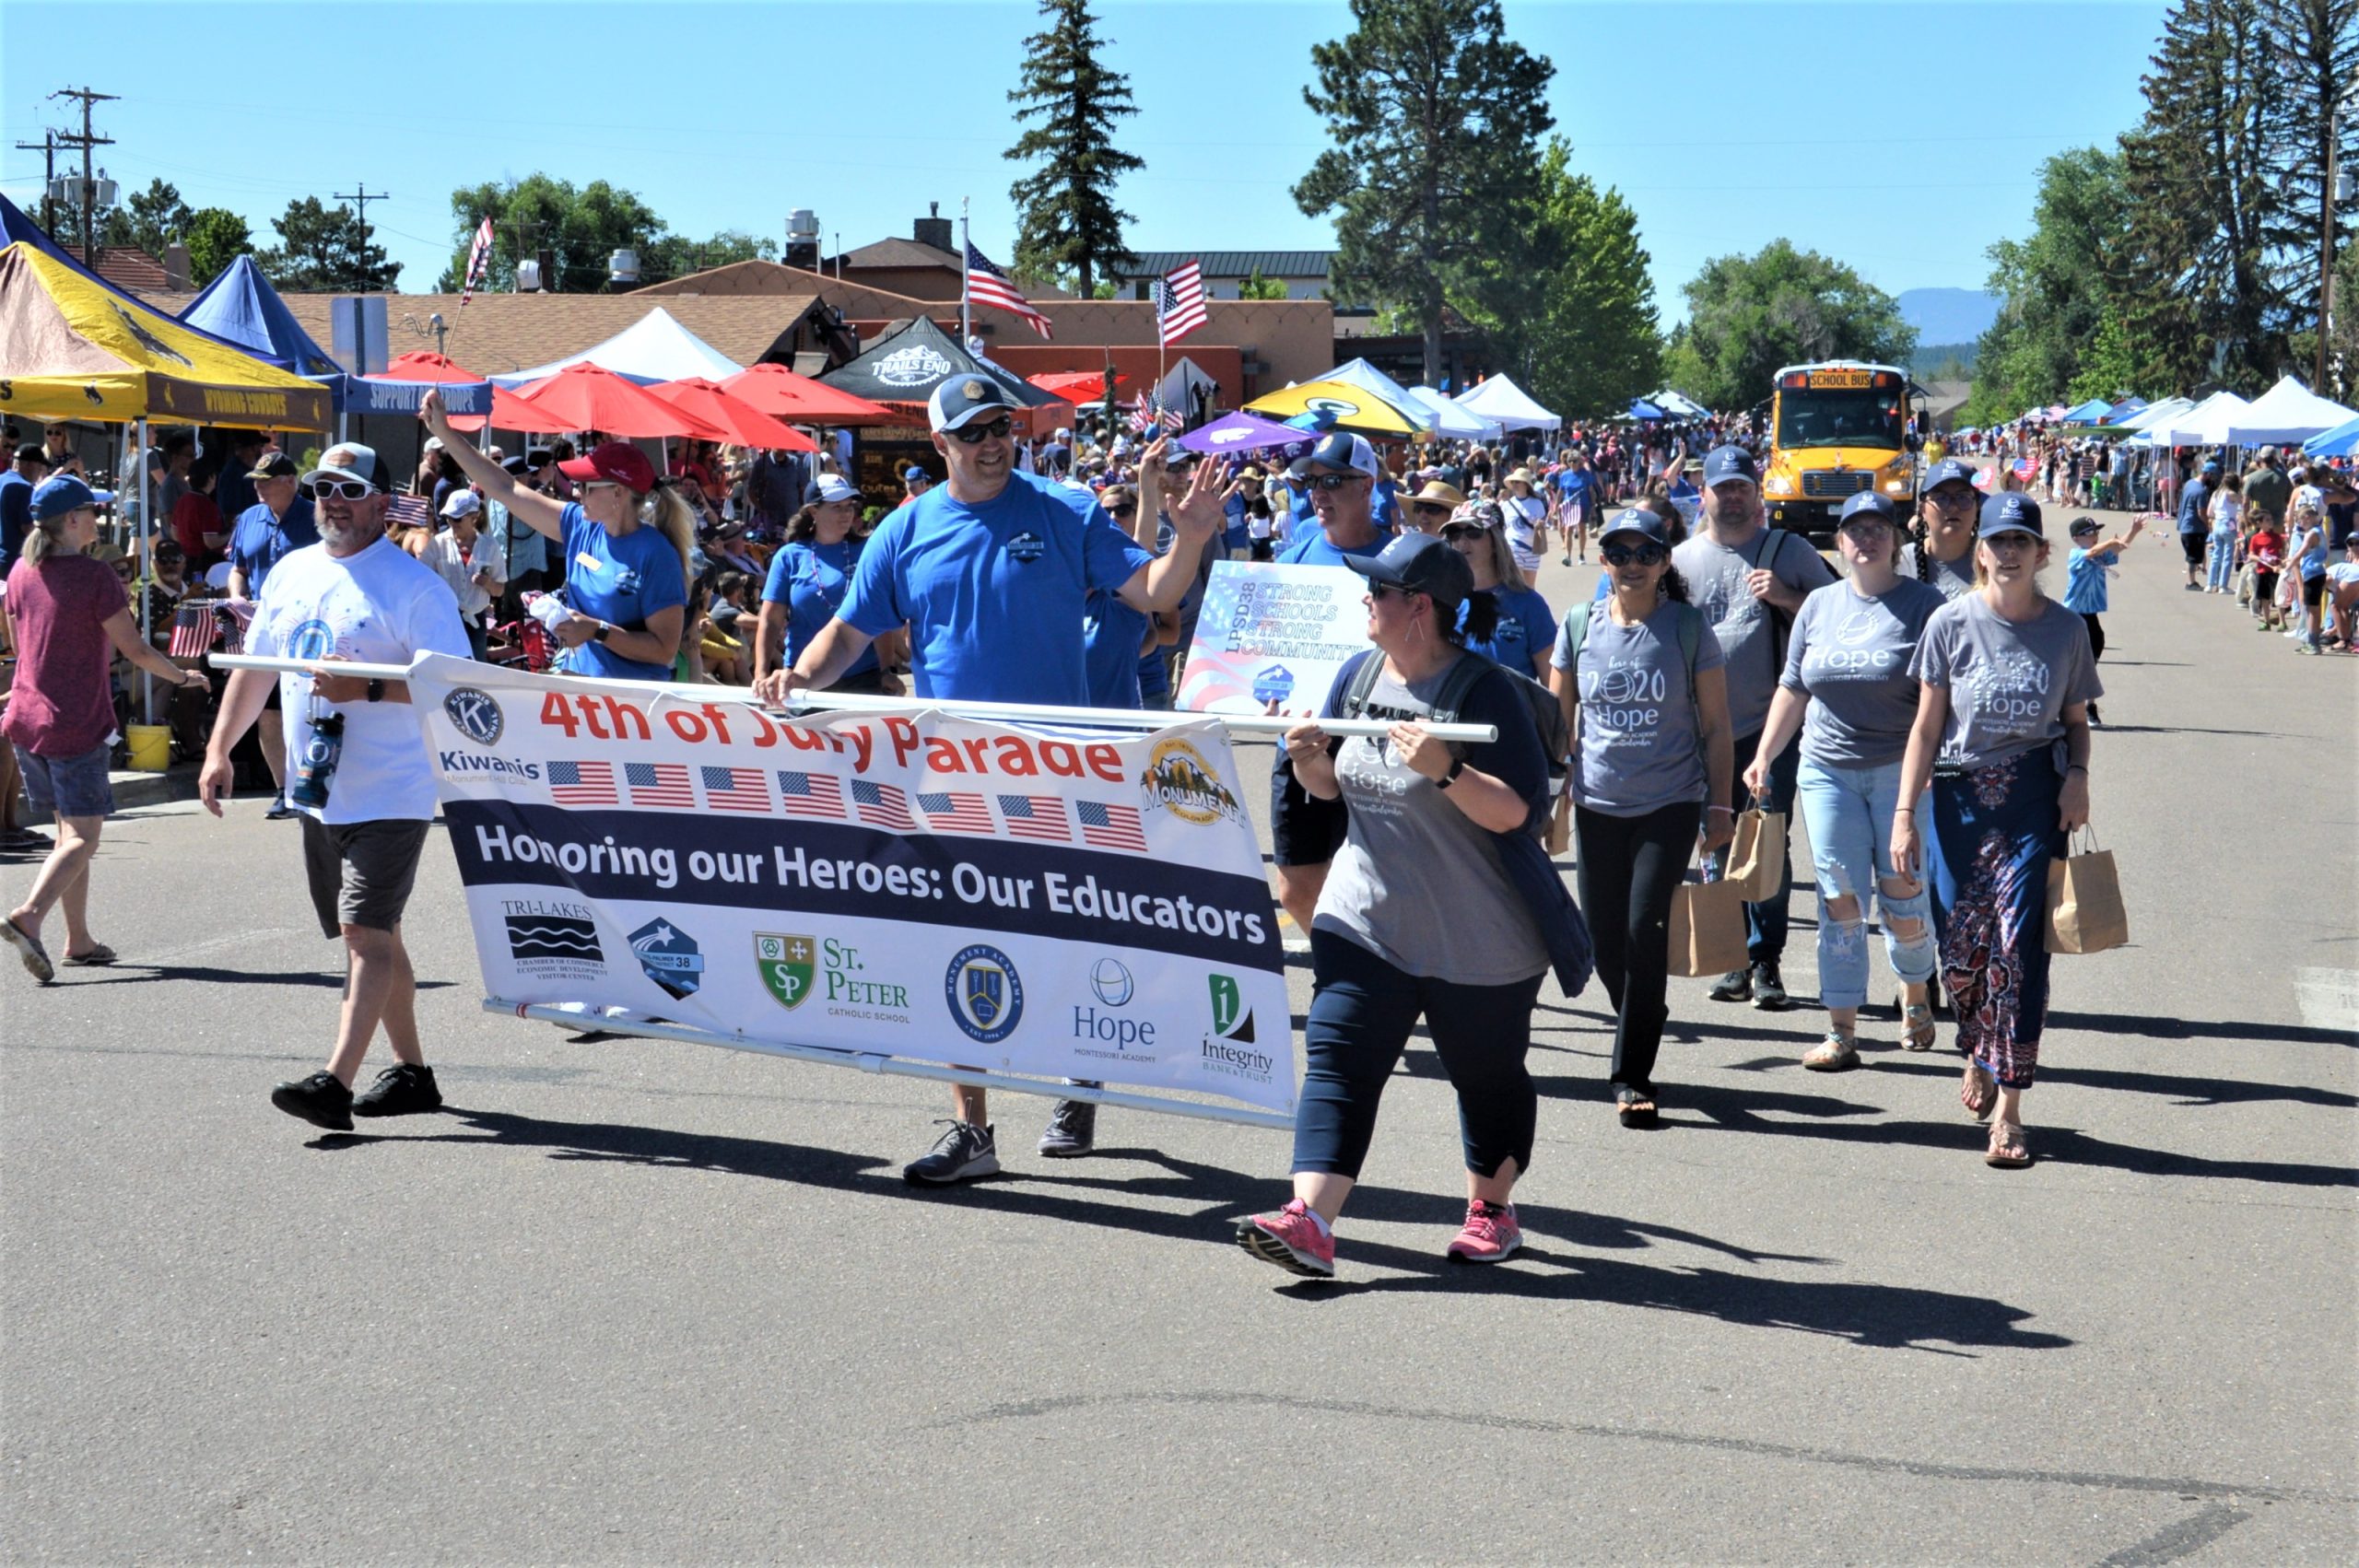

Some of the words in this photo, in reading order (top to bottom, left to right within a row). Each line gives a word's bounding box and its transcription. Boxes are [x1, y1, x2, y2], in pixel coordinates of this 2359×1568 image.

[872, 358, 920, 376] TRAILS
[921, 360, 951, 374] END
[1811, 373, 1848, 386] SCHOOL
[1851, 373, 1871, 386] BUS
[204, 389, 246, 413] WYOMING
[370, 383, 416, 410] SUPPORT
[1256, 582, 1333, 602] STRONG
[1226, 581, 1256, 654] LPSD38
[1250, 601, 1338, 622] SCHOOLS
[1246, 619, 1323, 640] STRONG
[1240, 639, 1363, 661] COMMUNITY
[1806, 647, 1890, 673] Hope
[450, 691, 490, 706] KIWANIS
[1596, 704, 1659, 731] Hope
[540, 691, 652, 741] 4th
[664, 703, 732, 744] of
[882, 716, 1125, 782] Parade
[440, 750, 540, 780] Kiwanis
[1341, 759, 1406, 797] Hope
[1141, 780, 1246, 829] MONUMENT
[475, 825, 677, 889] Honoring
[688, 850, 763, 883] our
[774, 846, 944, 899] Heroes:
[952, 862, 1034, 909] Our
[1043, 872, 1265, 944] Educators
[501, 900, 593, 920] TRI-LAKES
[517, 958, 554, 966] CHAMBER
[517, 965, 558, 974] ECONOMIC
[559, 965, 608, 977] DEVELOPMENT
[676, 957, 690, 967] 38
[948, 948, 986, 994] MONUMENT
[568, 973, 595, 981] CENTER
[992, 953, 1020, 1006] ACADEMY
[827, 1008, 872, 1019] CATHOLIC
[874, 1013, 910, 1024] SCHOOL
[1074, 1006, 1156, 1050] Hope
[1074, 1048, 1120, 1060] MONTESSORI
[1121, 1053, 1156, 1063] ACADEMY
[1203, 1062, 1233, 1075] BANK
[1239, 1068, 1273, 1084] TRUST
